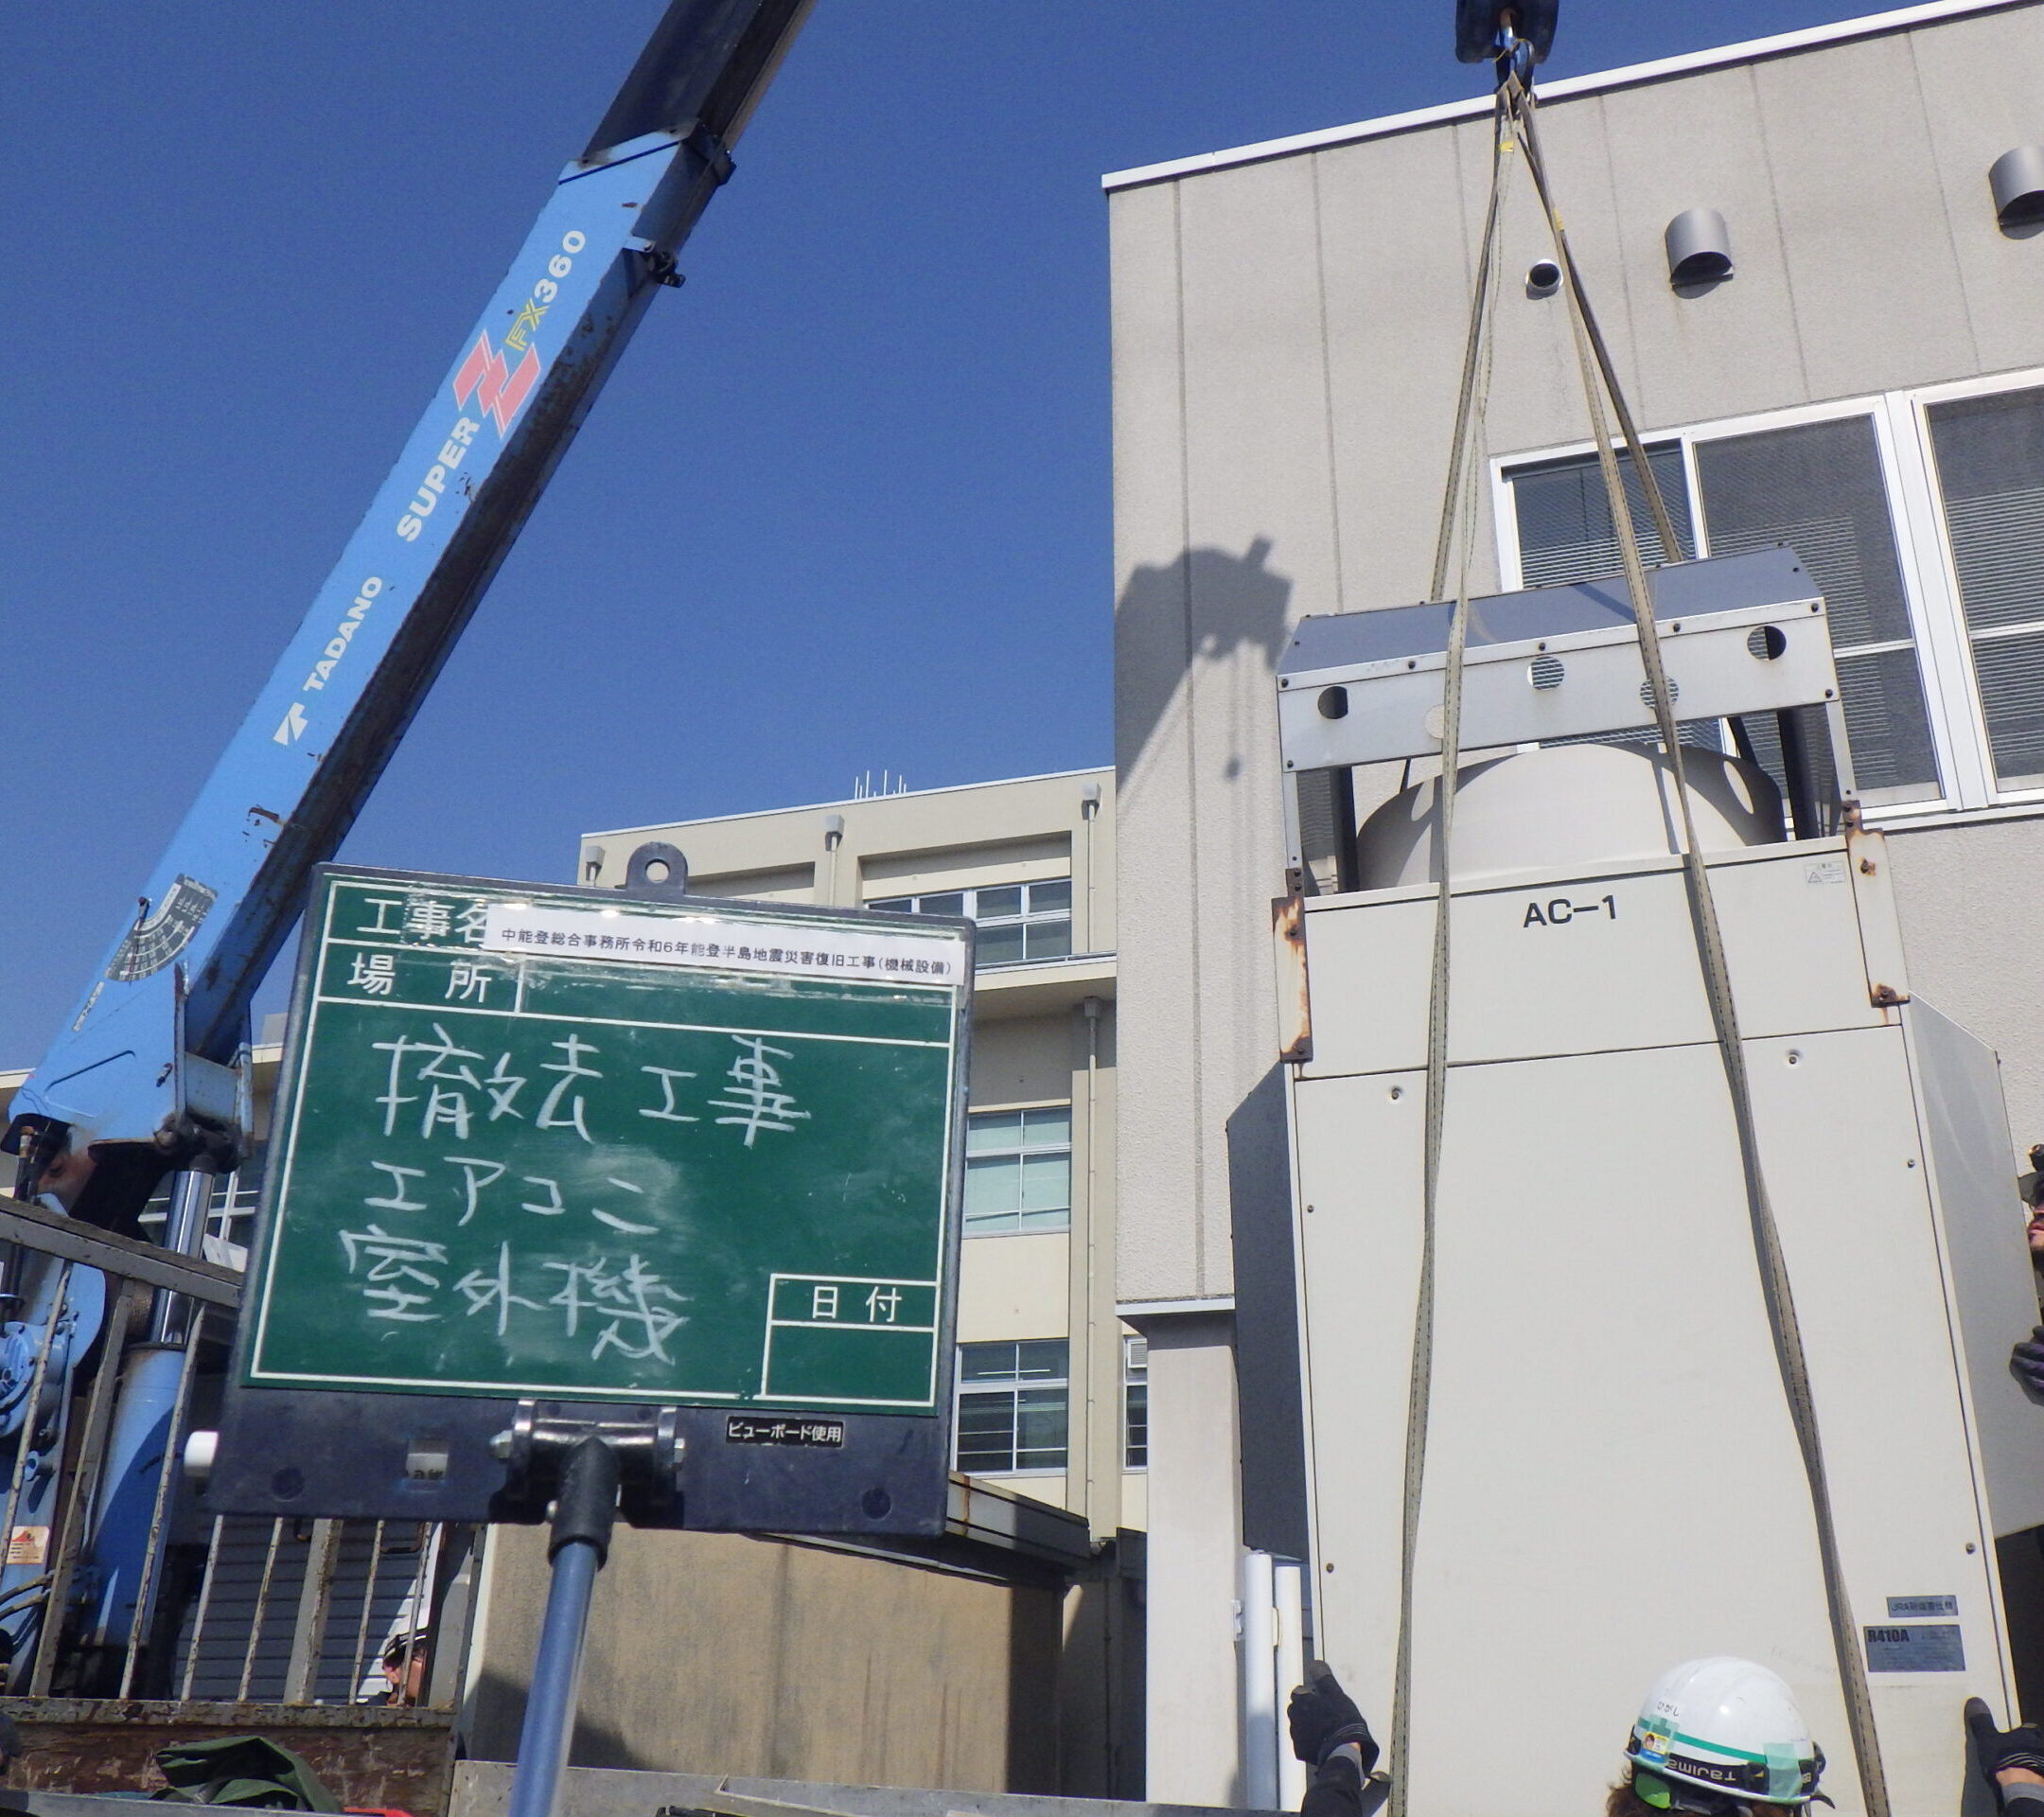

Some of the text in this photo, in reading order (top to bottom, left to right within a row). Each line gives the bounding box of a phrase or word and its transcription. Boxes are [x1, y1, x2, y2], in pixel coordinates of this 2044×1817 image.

[396, 416, 481, 542] SUPER
[303, 576, 382, 691] TADANO
[1523, 894, 1616, 927] AC-1
[364, 1156, 660, 1232] エアコン
[339, 1225, 695, 1366] 室外機
[728, 1421, 842, 1443] ビューボード使用
[1867, 1629, 1910, 1642] R410A
